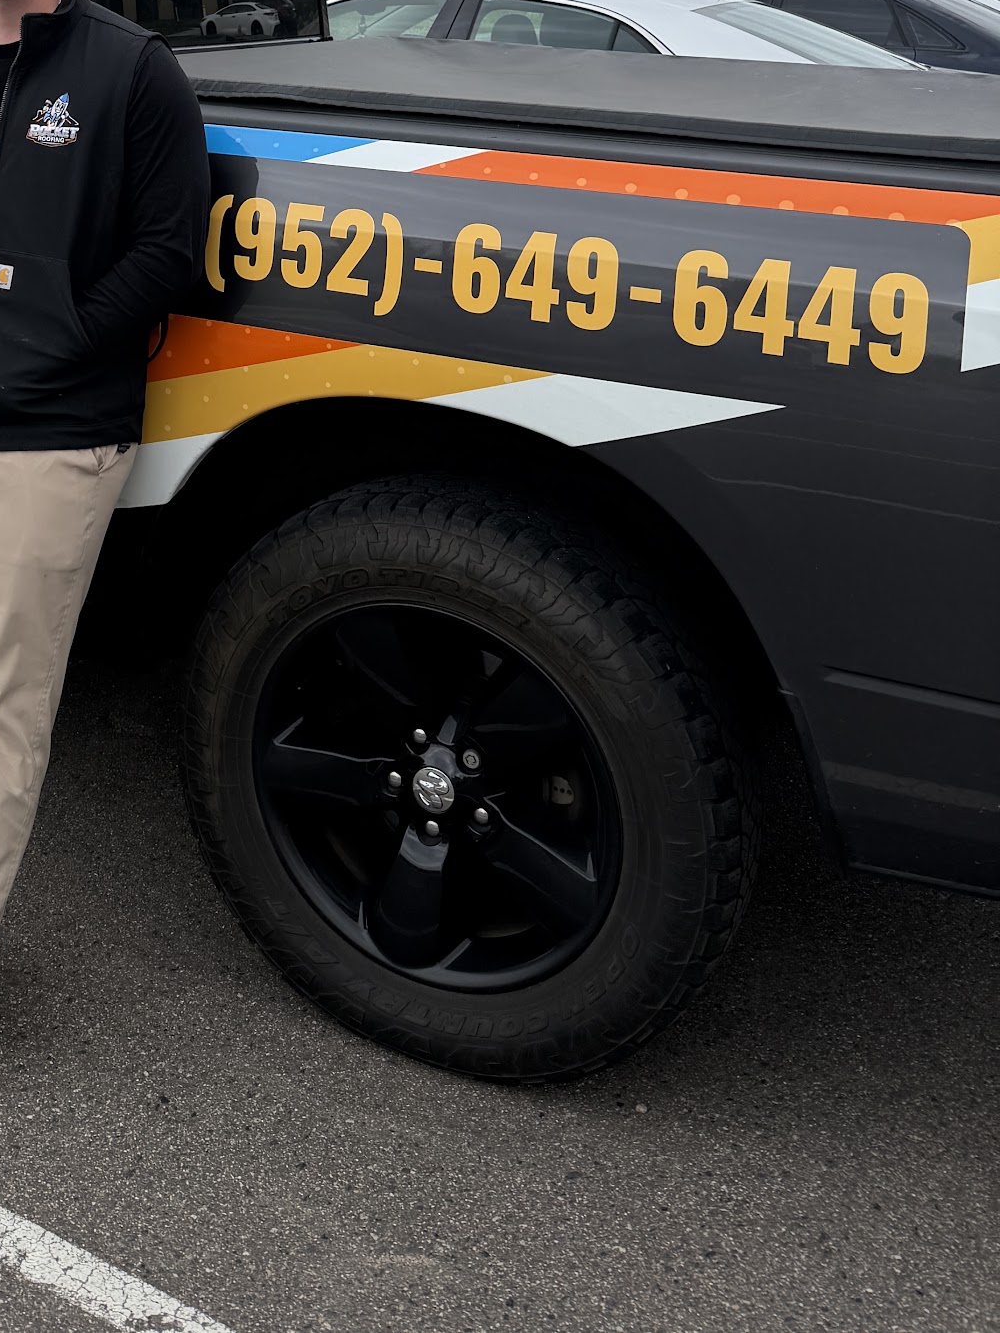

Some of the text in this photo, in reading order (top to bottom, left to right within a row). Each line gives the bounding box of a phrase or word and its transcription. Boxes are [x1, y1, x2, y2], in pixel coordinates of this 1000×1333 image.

[29, 124, 79, 138] ROCKET
[205, 195, 929, 374] (952)-649-6449
[266, 567, 533, 628] TOYO TIRES
[342, 978, 549, 1039] COUNTRY
